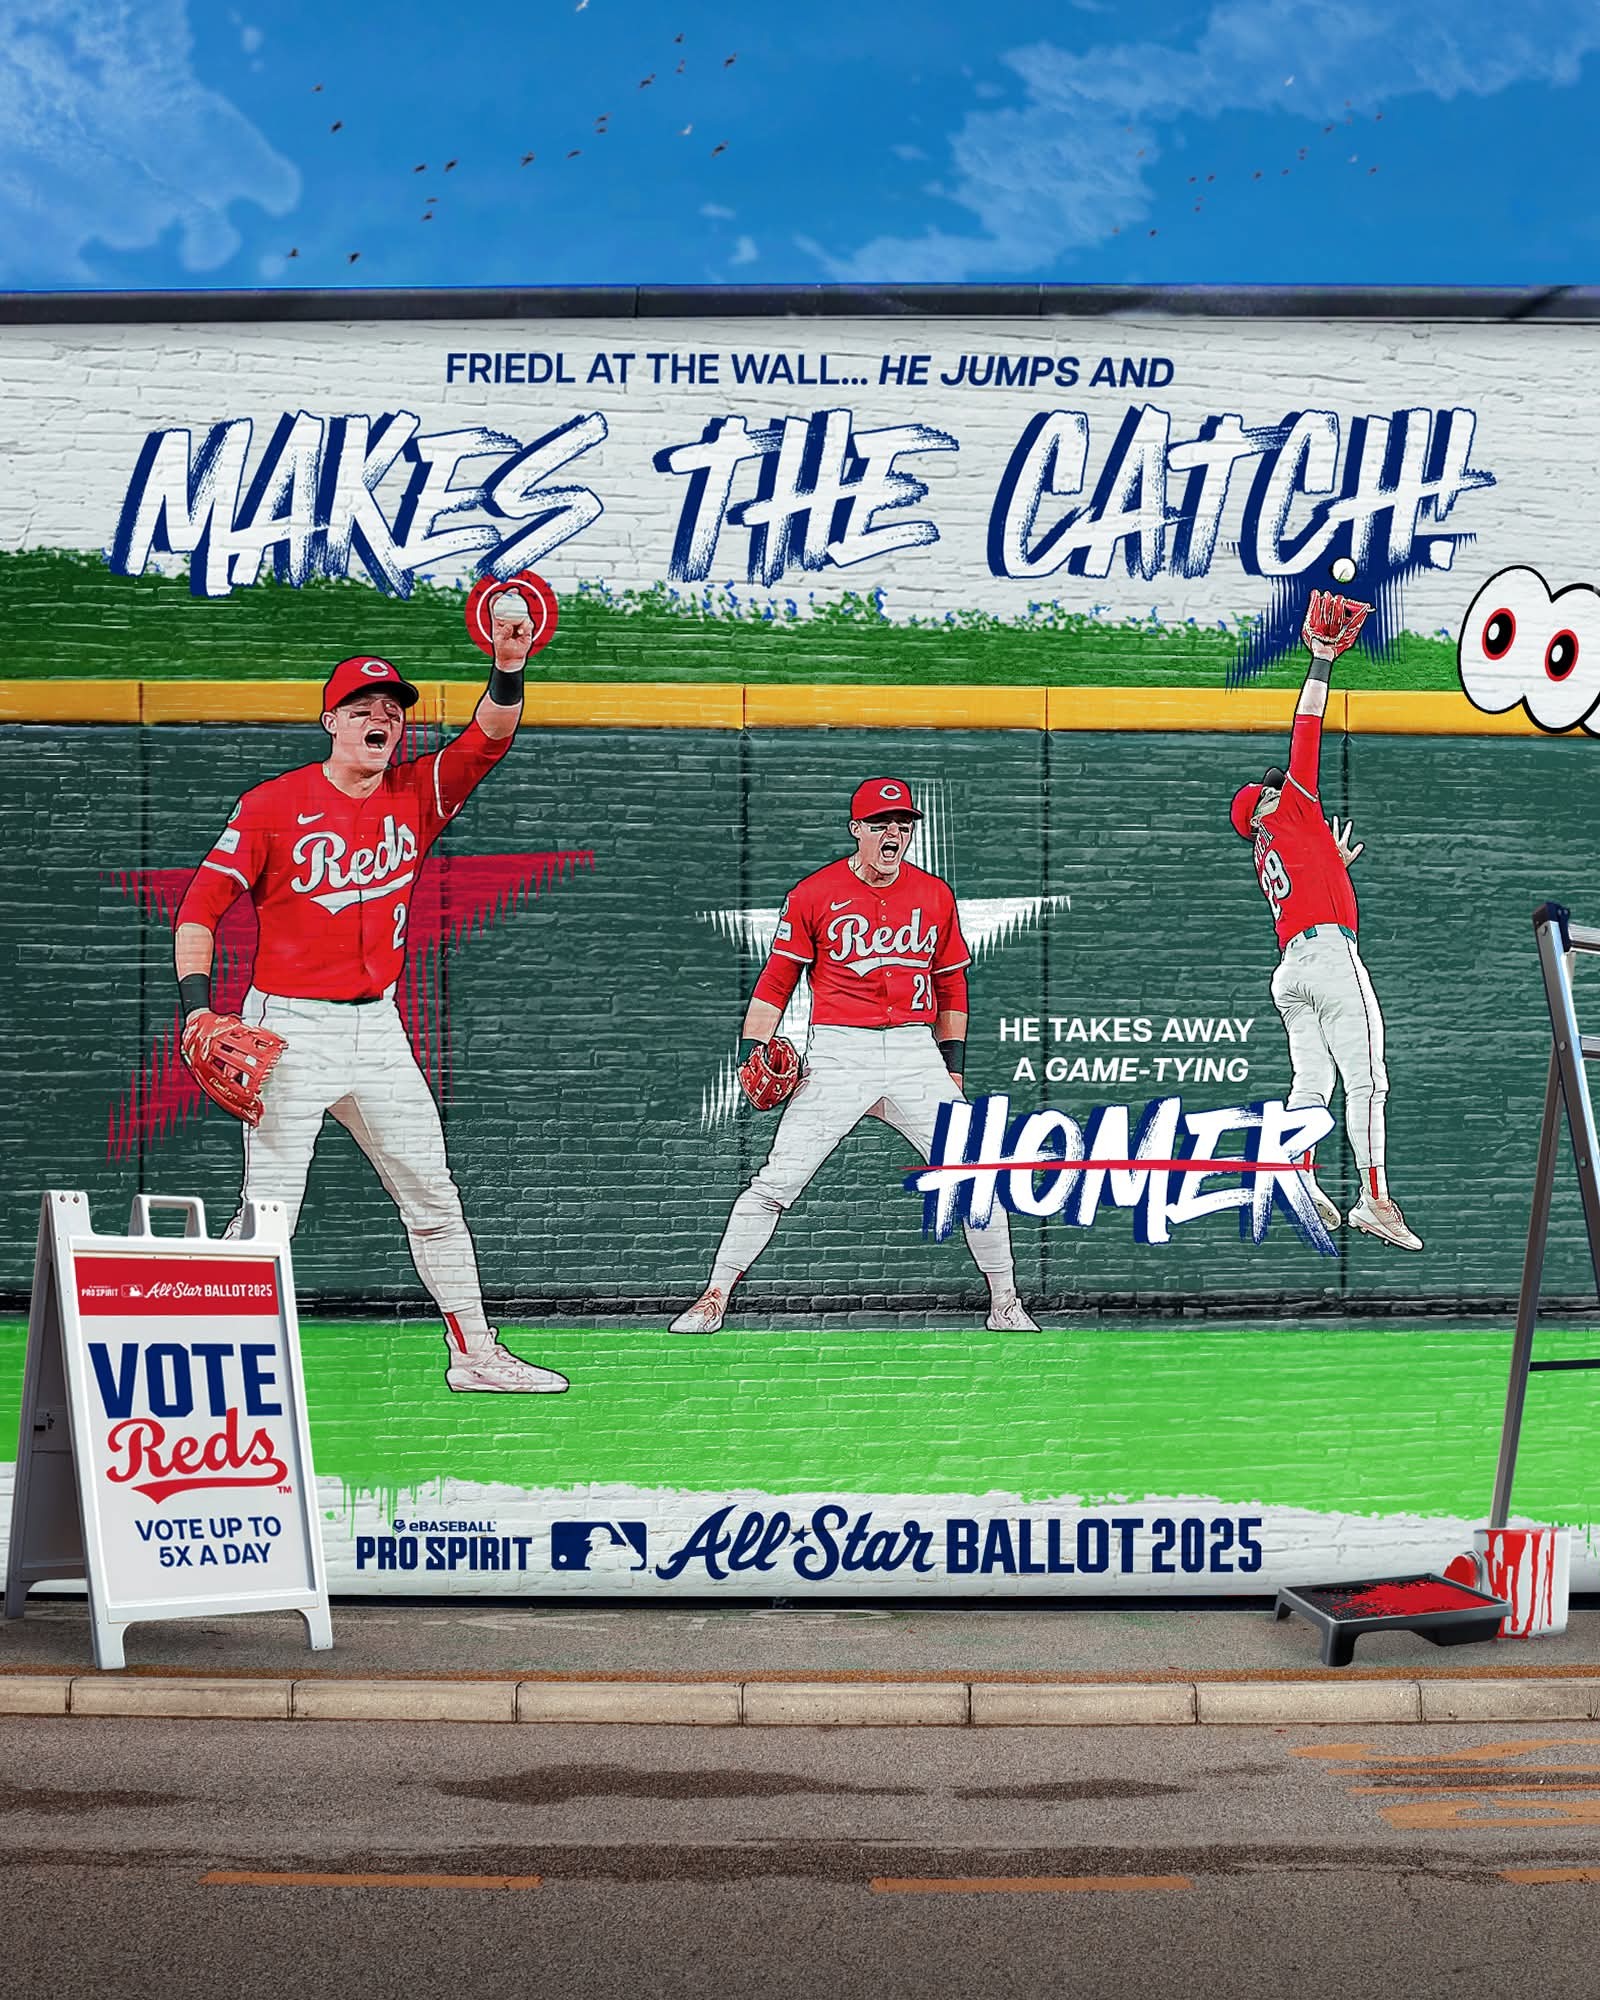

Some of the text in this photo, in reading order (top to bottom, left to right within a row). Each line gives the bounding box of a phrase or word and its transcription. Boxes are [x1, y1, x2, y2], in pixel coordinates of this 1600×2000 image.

[446, 352, 1174, 388] FRIEDL AT THE WALL... HE JUMPS AND
[110, 404, 1497, 600] MAKES THE CATCH!
[290, 814, 418, 914] Reds
[828, 908, 938, 977] Reds
[1000, 1017, 1255, 1043] HE TAKES AWAY
[1013, 1057, 1249, 1082] A GAME-TYING
[903, 1094, 1339, 1258] HOMER
[204, 1284, 246, 1297] BALLOT
[248, 1284, 273, 1297] 2025
[88, 1343, 282, 1419] VOTE
[106, 1407, 289, 1504] Reds
[135, 1516, 282, 1541] VOTE UP TO
[356, 1536, 418, 1570] PRO
[425, 1536, 533, 1571] SPIRIT
[946, 1518, 1144, 1574] BALLOT
[1151, 1517, 1262, 1574] 2025
[409, 1521, 496, 1532] eBASEBALL
[159, 1542, 271, 1568] 5X A DAY
